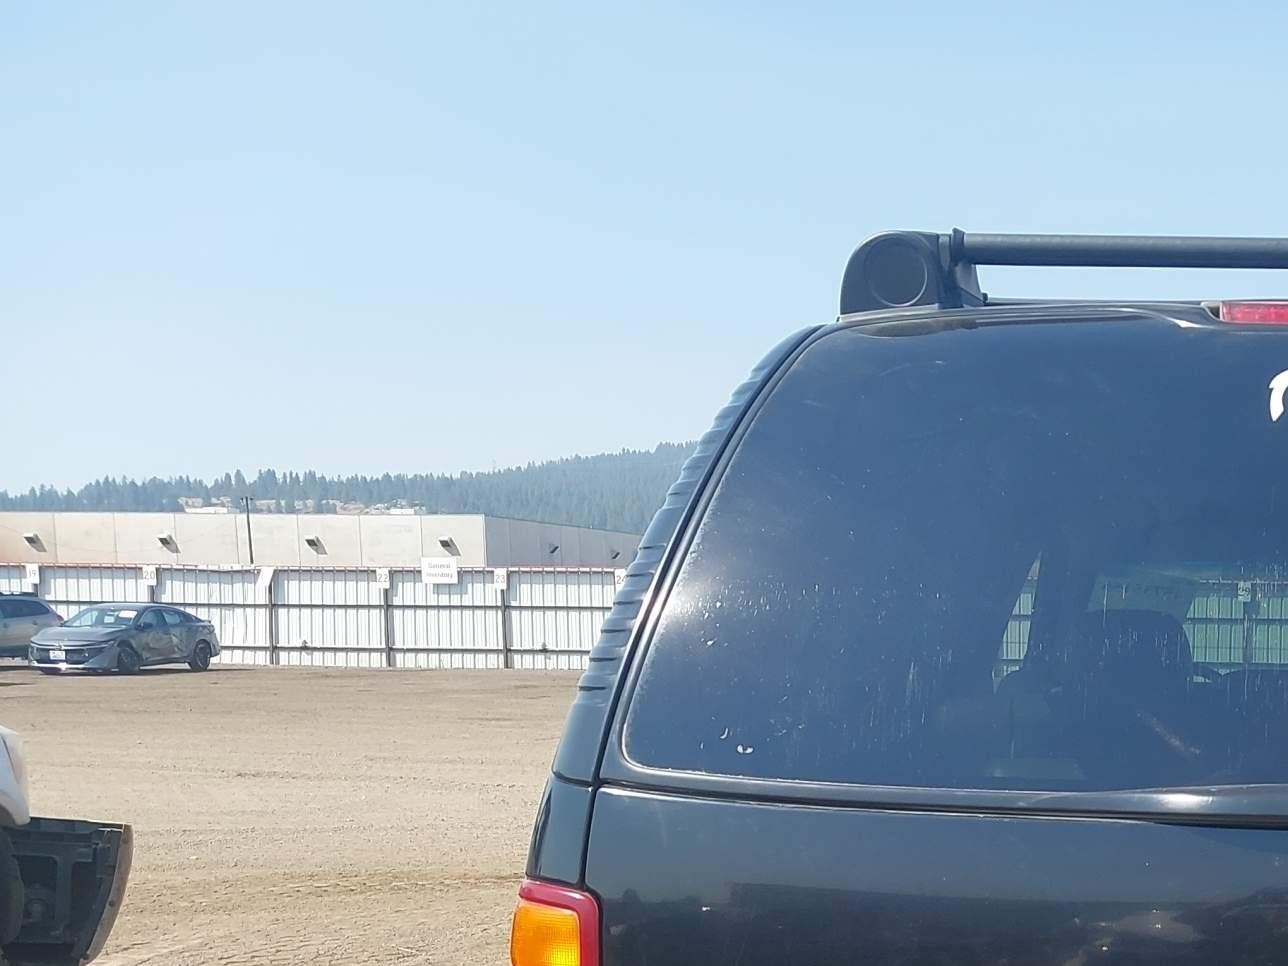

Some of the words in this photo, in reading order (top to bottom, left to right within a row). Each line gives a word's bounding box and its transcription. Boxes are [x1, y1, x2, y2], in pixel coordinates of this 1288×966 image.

[143, 570, 156, 581] 20
[377, 573, 389, 582] 22
[495, 574, 506, 584] 23
